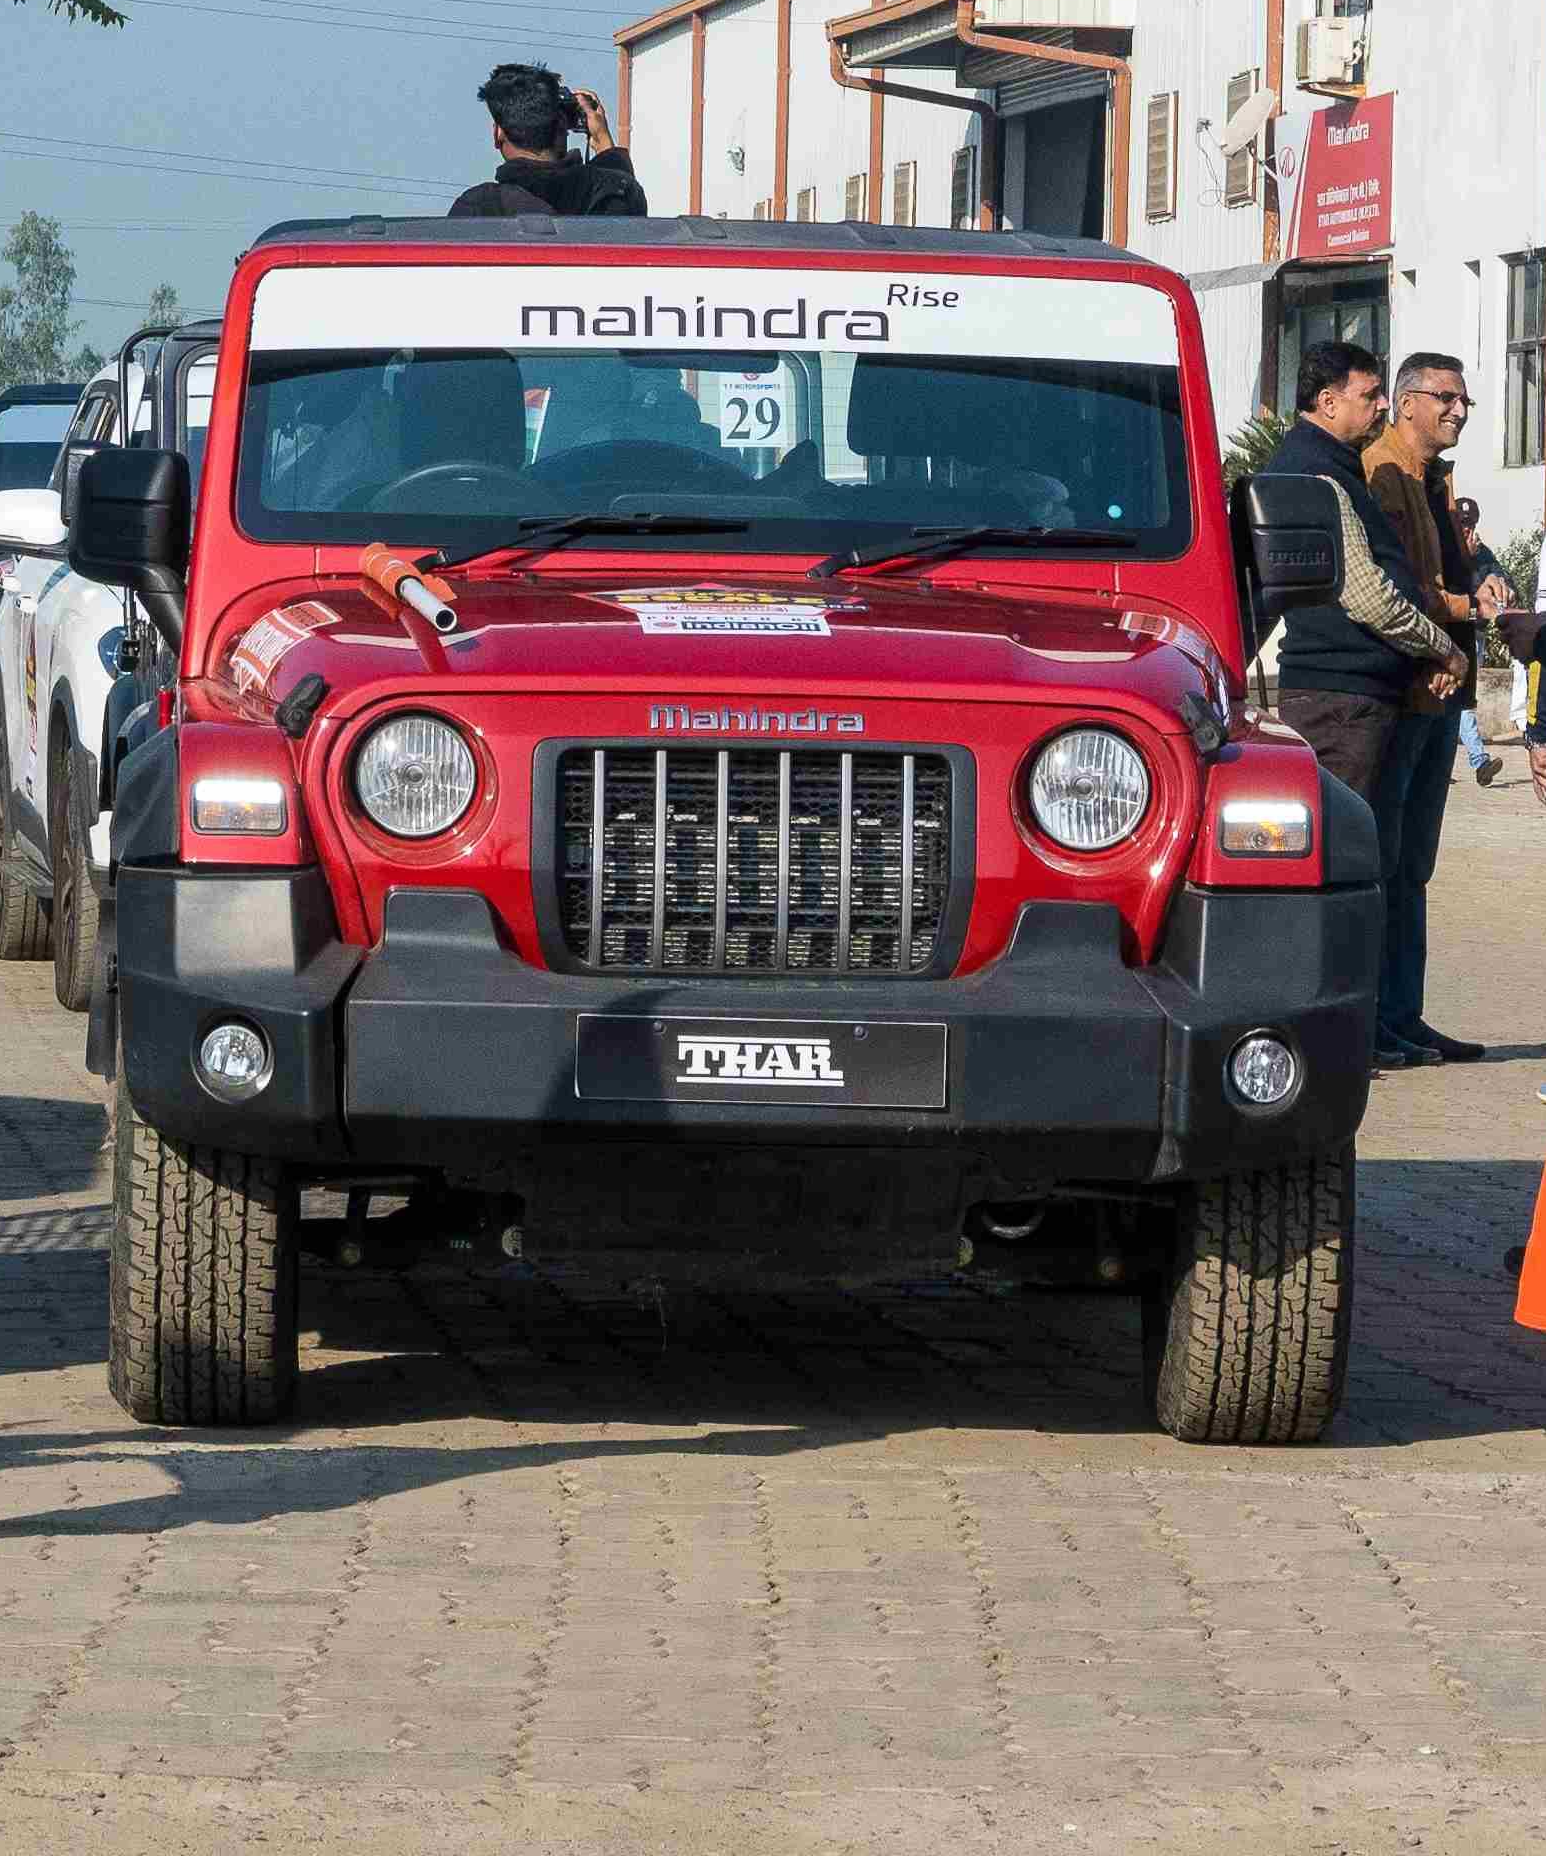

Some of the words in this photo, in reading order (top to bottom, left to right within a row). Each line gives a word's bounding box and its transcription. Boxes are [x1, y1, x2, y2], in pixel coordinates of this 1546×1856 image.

[521, 296, 890, 342] mahindra
[886, 283, 959, 308] Rise
[726, 397, 781, 441] 29
[686, 622, 816, 631] IndianOil
[650, 704, 865, 732] Mahindra
[677, 1040, 845, 1082] THAR
